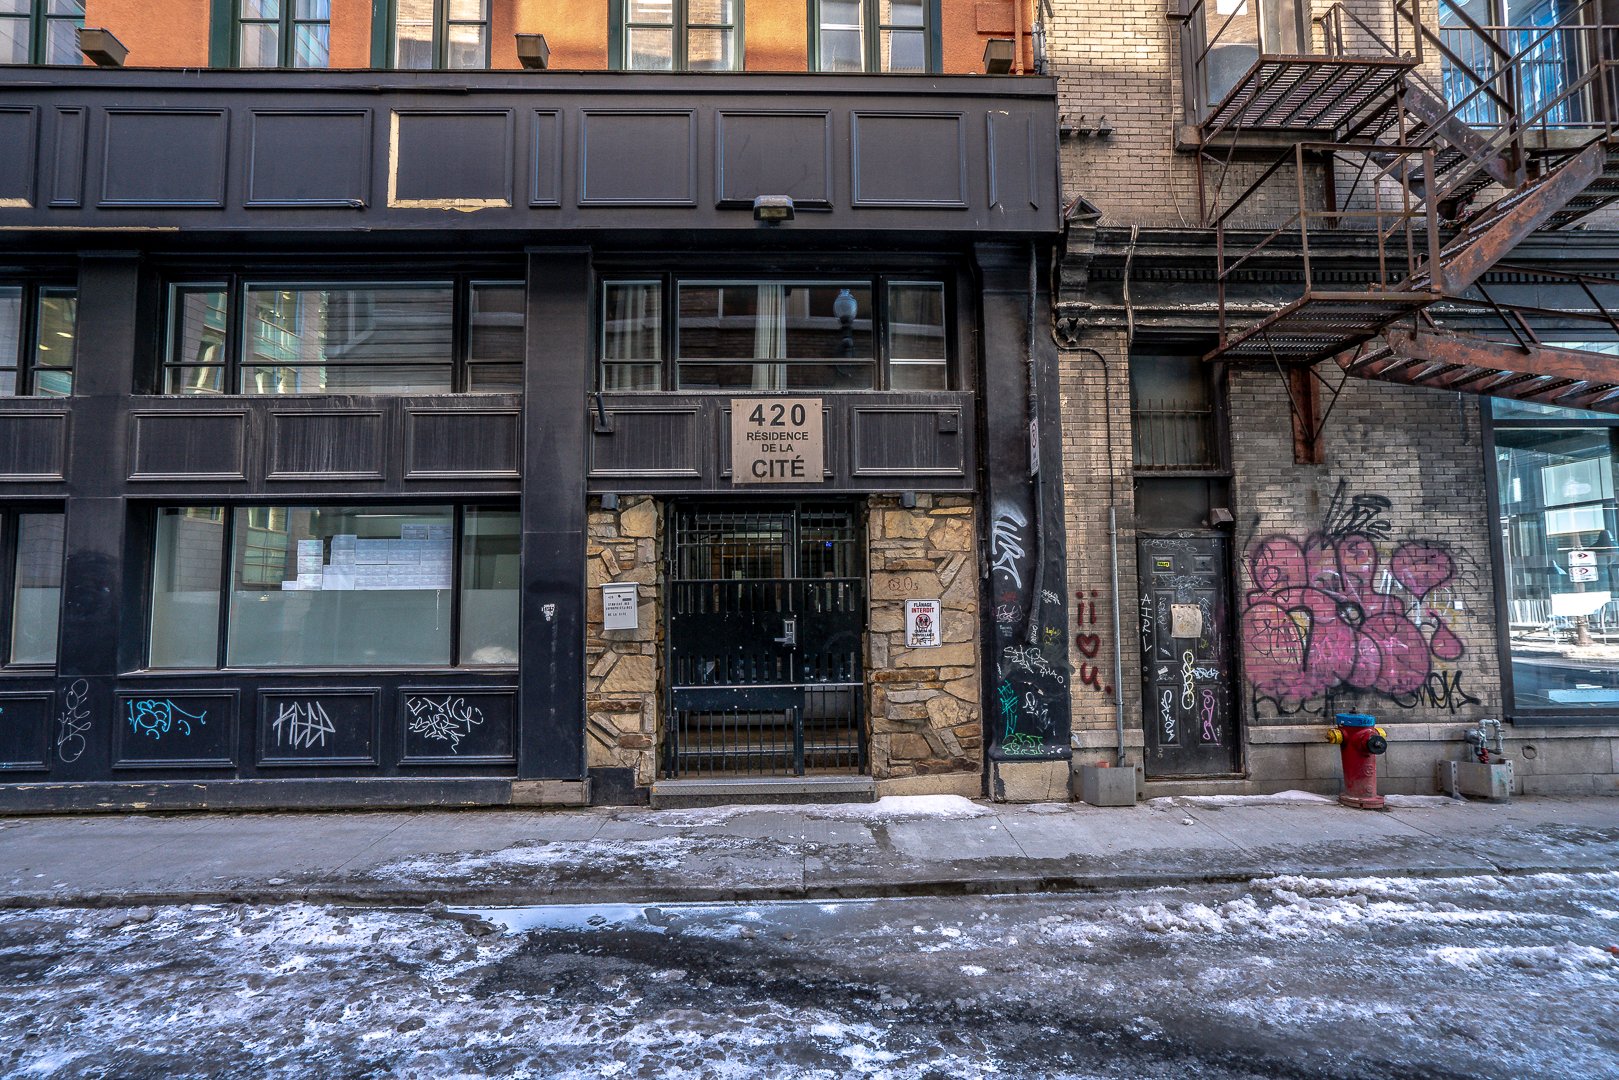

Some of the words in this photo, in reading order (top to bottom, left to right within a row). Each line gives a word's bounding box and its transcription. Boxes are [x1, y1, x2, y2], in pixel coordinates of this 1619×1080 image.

[748, 403, 806, 427] 420
[746, 430, 809, 441] RÉSIDENCE
[761, 443, 776, 453] DE
[779, 443, 794, 453] LA
[751, 455, 805, 478] CITÉ
